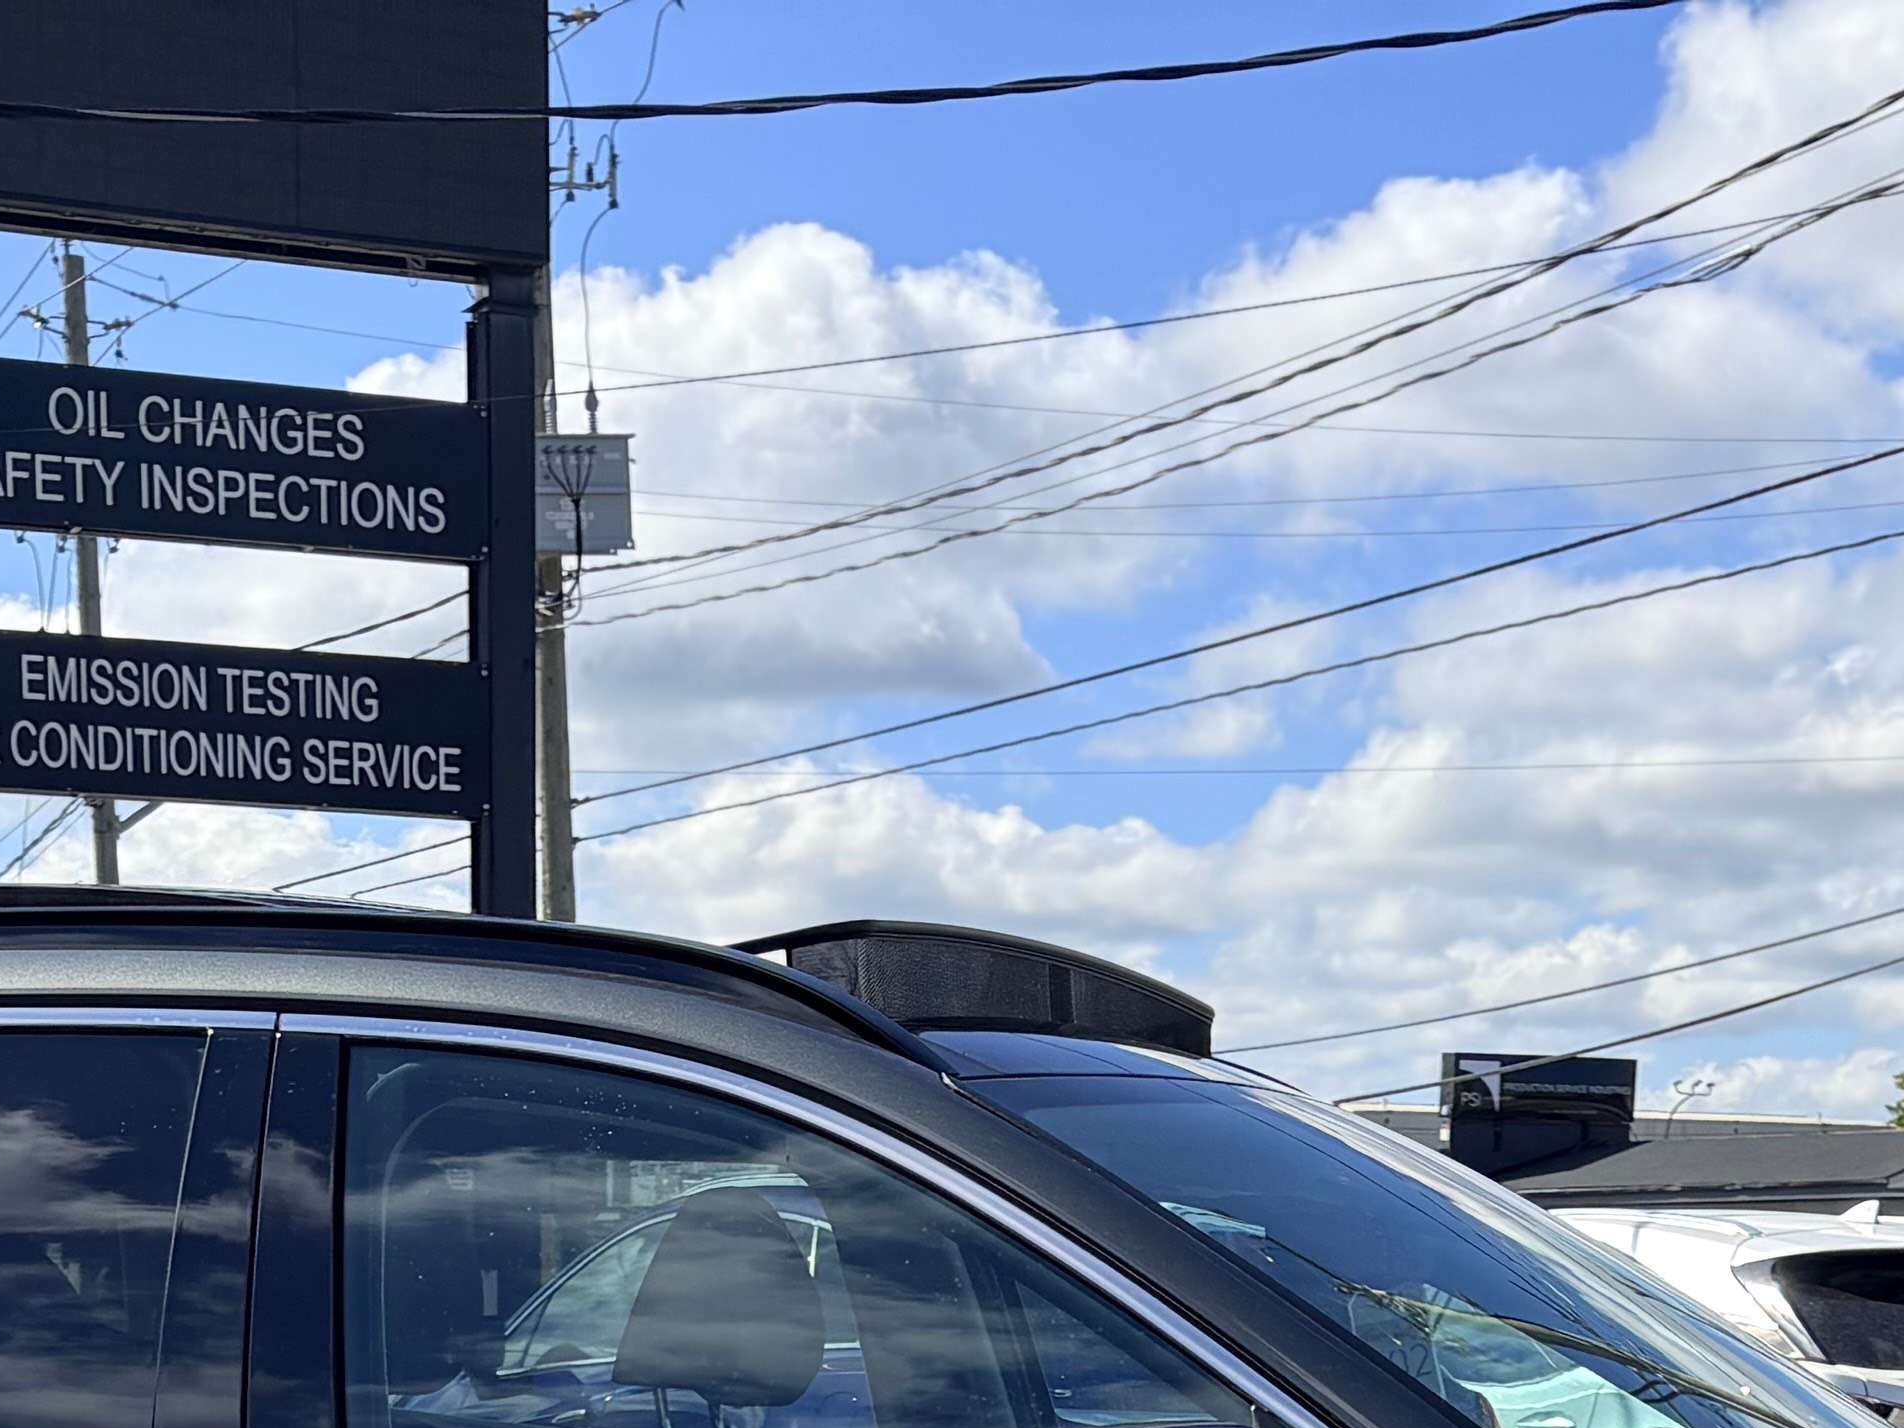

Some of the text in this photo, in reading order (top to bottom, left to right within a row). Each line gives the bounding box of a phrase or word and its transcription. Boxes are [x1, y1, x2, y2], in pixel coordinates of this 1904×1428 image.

[48, 386, 364, 461] OIL CHANGES
[140, 462, 446, 534] INSPECTIONS
[21, 654, 379, 722] EMISSION TESTING
[10, 719, 292, 782] CONDITIONING
[302, 738, 462, 792] SERVICE
